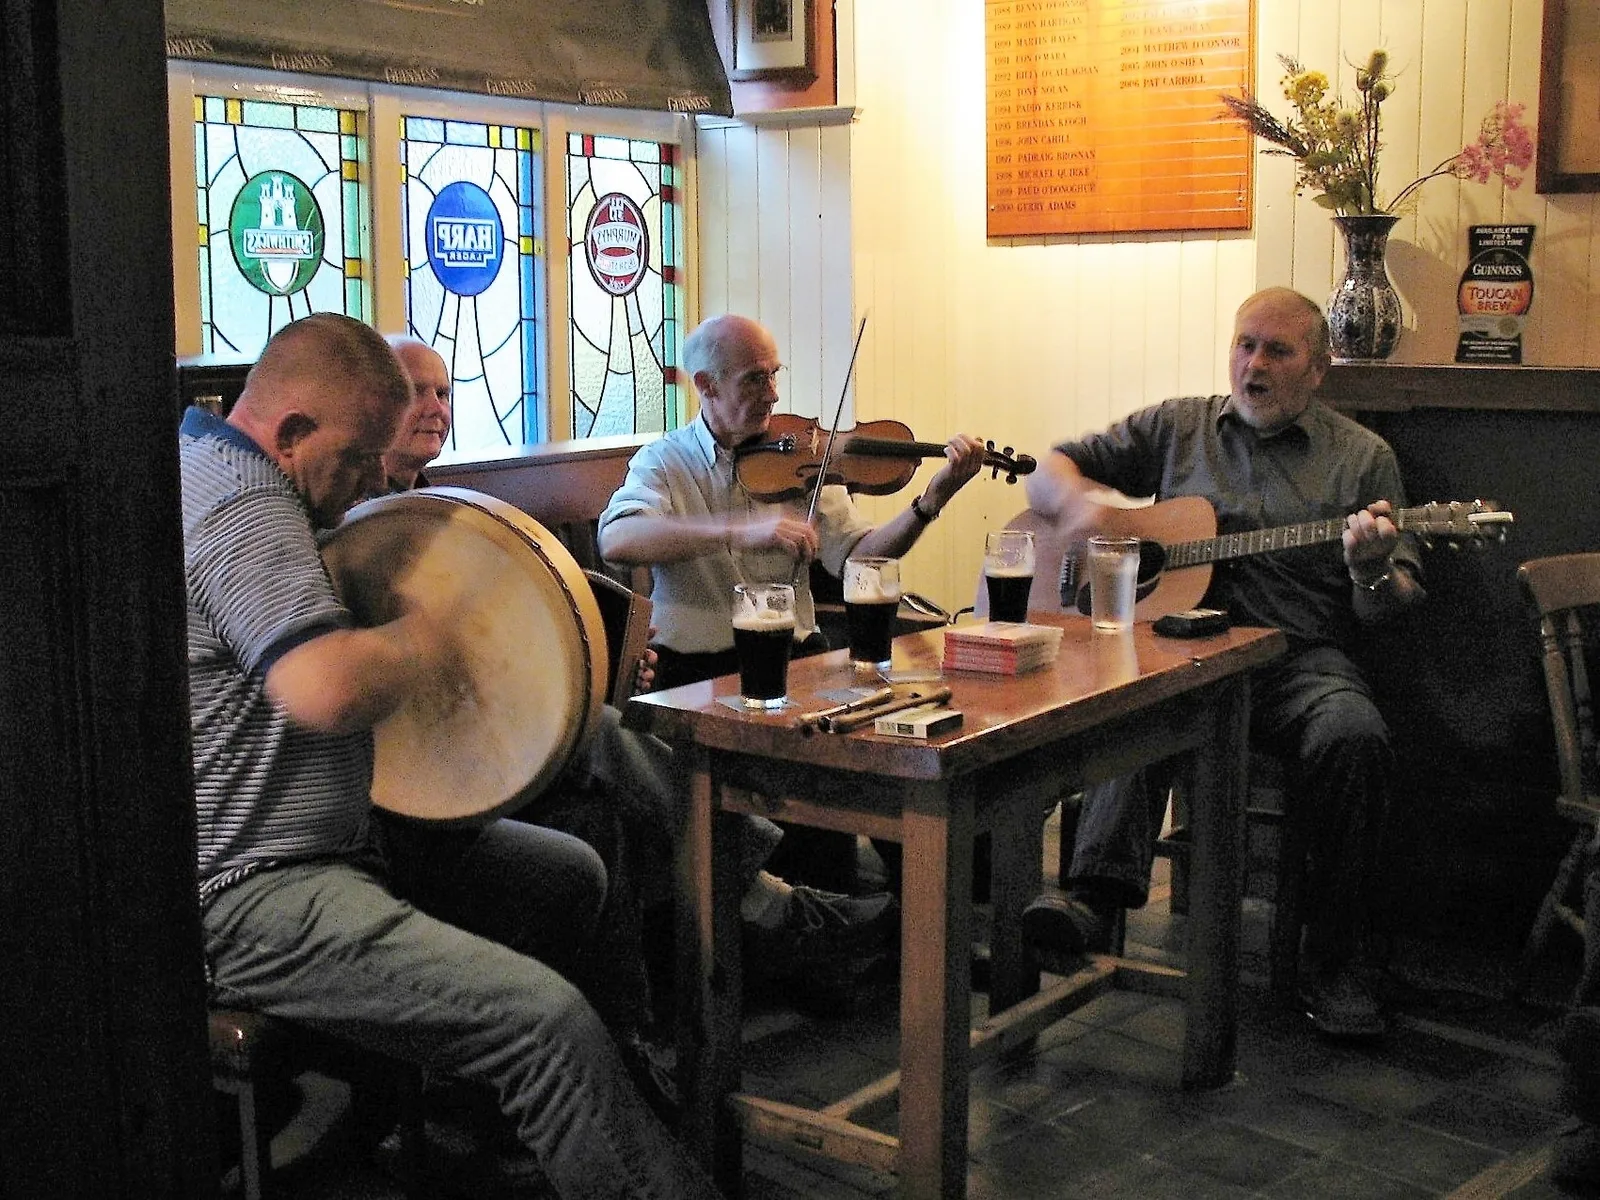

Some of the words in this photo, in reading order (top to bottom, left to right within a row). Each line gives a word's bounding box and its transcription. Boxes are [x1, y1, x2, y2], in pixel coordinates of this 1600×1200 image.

[1015, 20, 1037, 30] JOHN
[1143, 41, 1188, 53] MATTHEW
[1143, 59, 1168, 70] JOHN
[1143, 77, 1160, 88] PAT
[1162, 74, 1206, 87] CARROLL
[1017, 86, 1038, 97] TONY
[1040, 84, 1069, 94] NOLAN
[1016, 103, 1041, 114] PADDY
[1016, 118, 1055, 130] BRENDAN
[1017, 135, 1038, 146] JOHN
[1047, 199, 1077, 211] ADAMS
[1472, 263, 1523, 276] GUINNESS
[1468, 286, 1523, 300] TOUCAN
[1477, 301, 1512, 311] BREW
